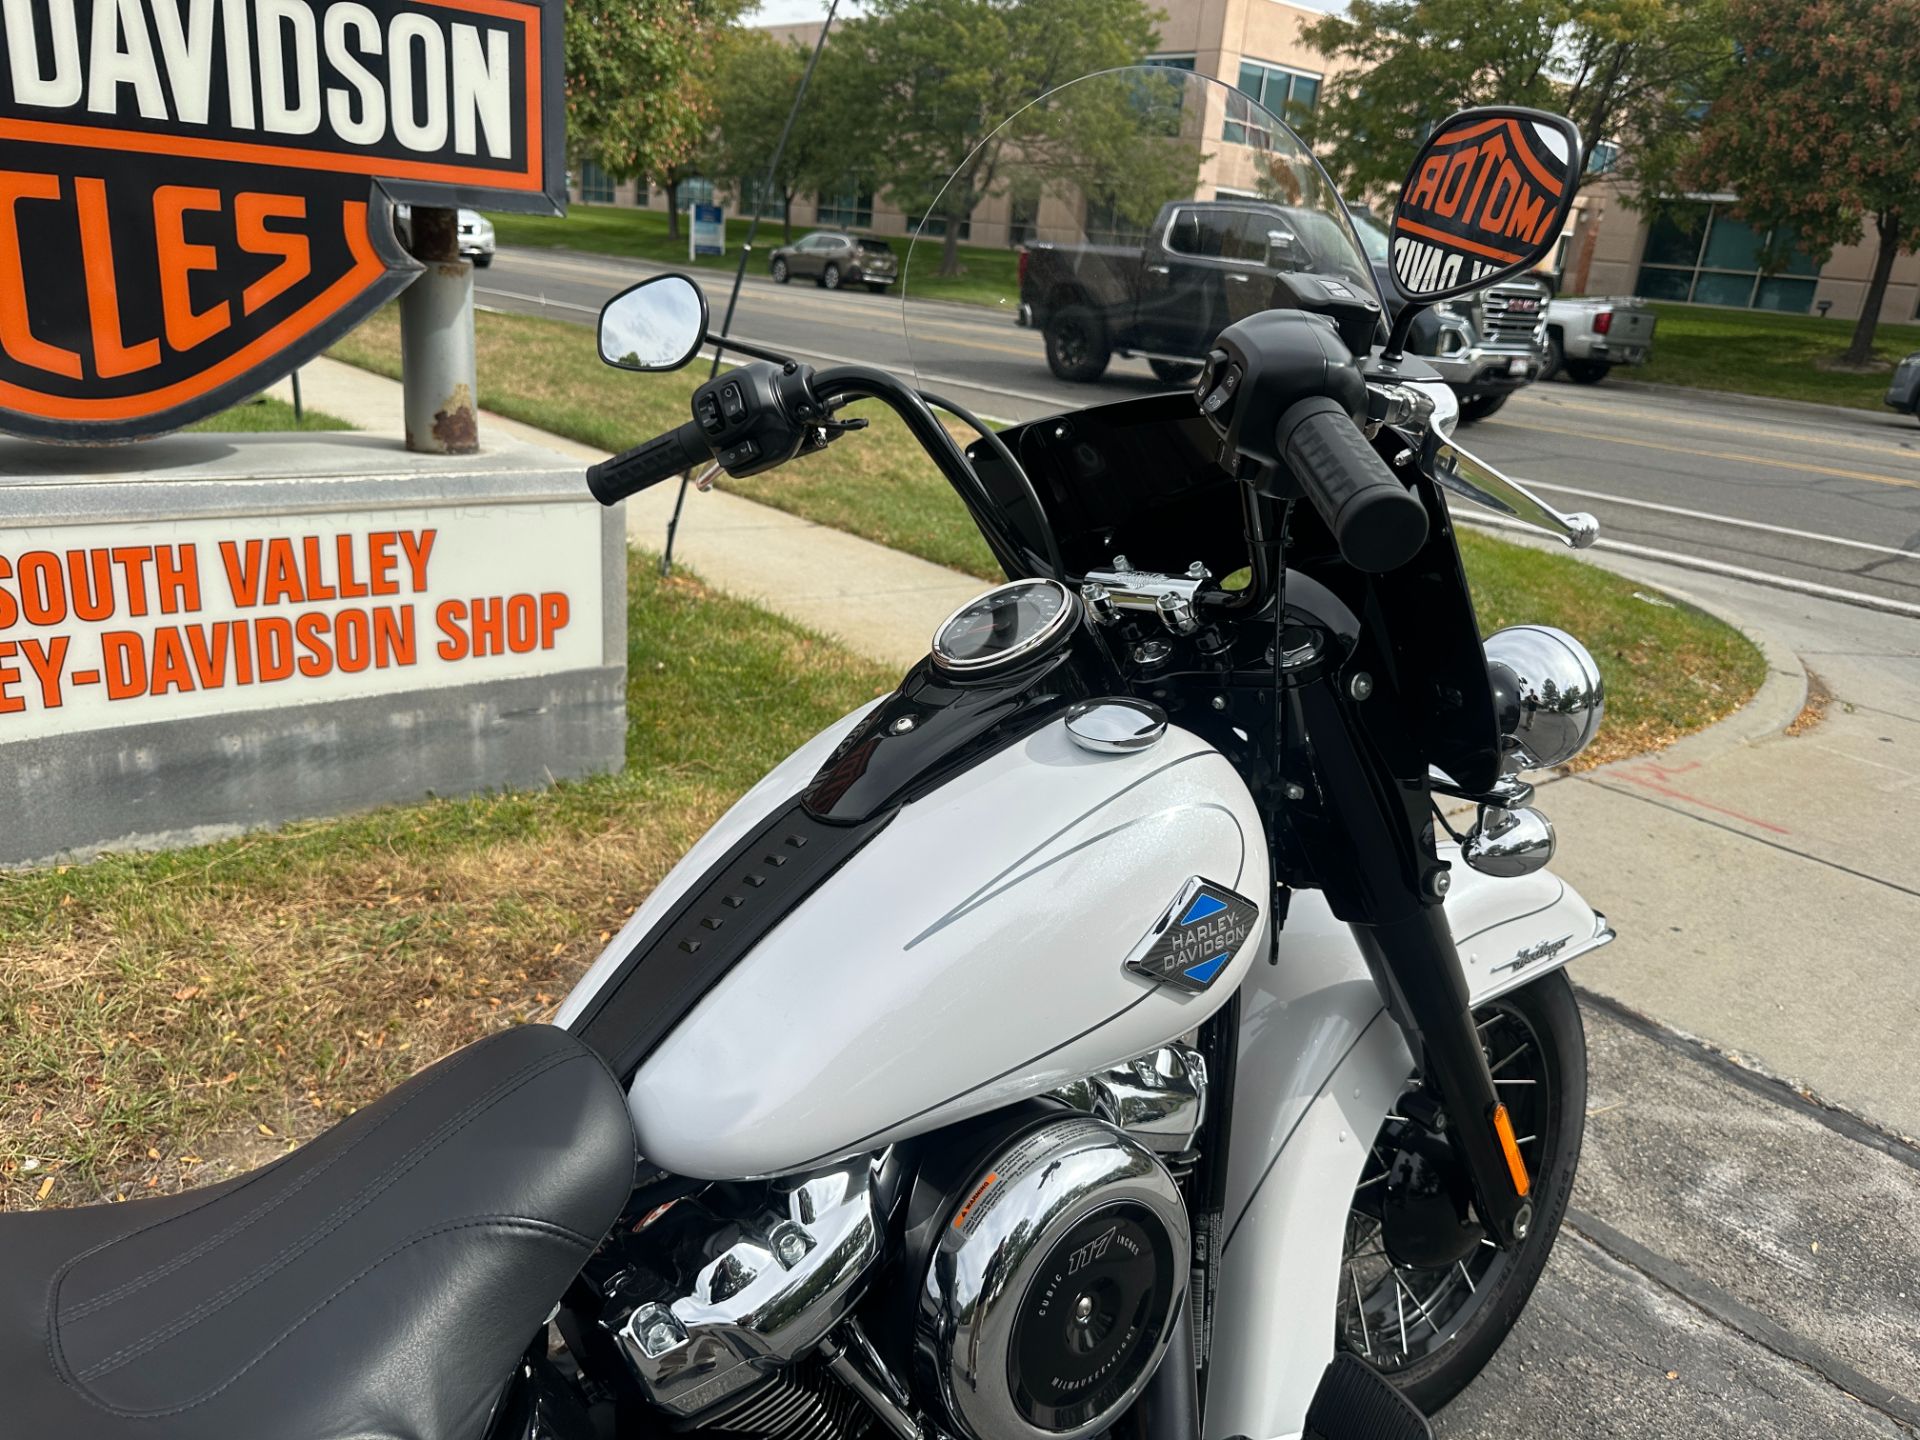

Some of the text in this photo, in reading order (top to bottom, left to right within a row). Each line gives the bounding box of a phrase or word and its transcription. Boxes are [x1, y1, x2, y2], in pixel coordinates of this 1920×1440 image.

[2, 0, 512, 160] DAVIDSON
[218, 529, 438, 608] VALLEY
[0, 592, 571, 714] EY-DAVIDSON SHOP
[1163, 924, 1245, 972] DAVIDSON
[965, 1181, 990, 1211] WARNING
[1068, 1226, 1117, 1276] 117
[1116, 1234, 1140, 1256] INCHES
[1038, 1273, 1062, 1316] CUBIC
